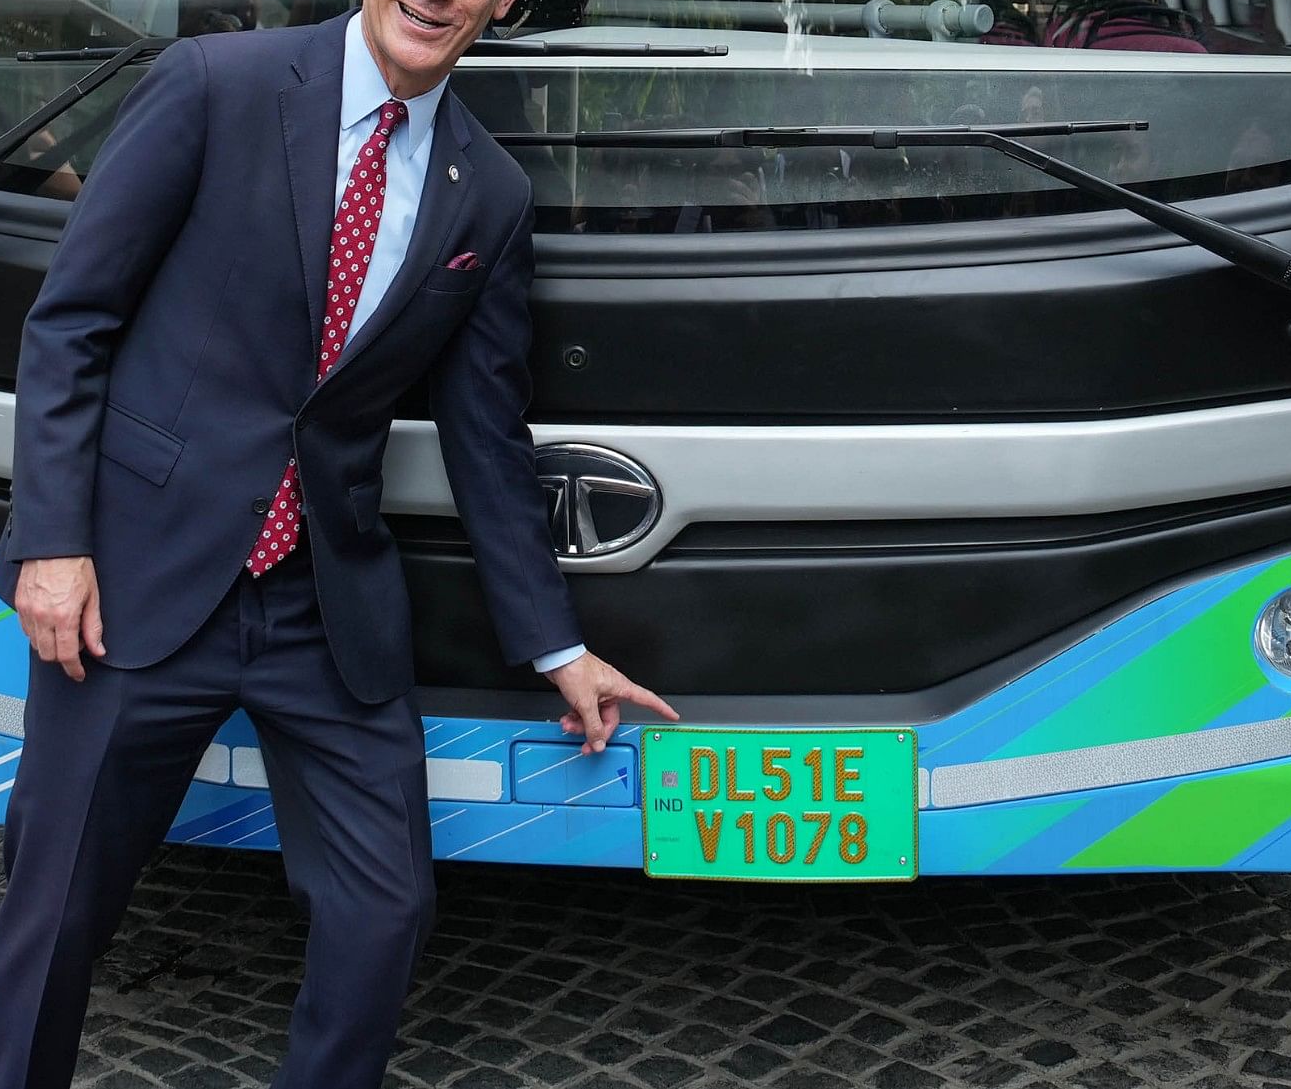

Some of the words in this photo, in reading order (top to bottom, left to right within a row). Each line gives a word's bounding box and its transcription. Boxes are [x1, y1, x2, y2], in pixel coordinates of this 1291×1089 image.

[689, 746, 865, 802] DL51E
[654, 797, 683, 812] IND
[694, 808, 869, 865] V1078
